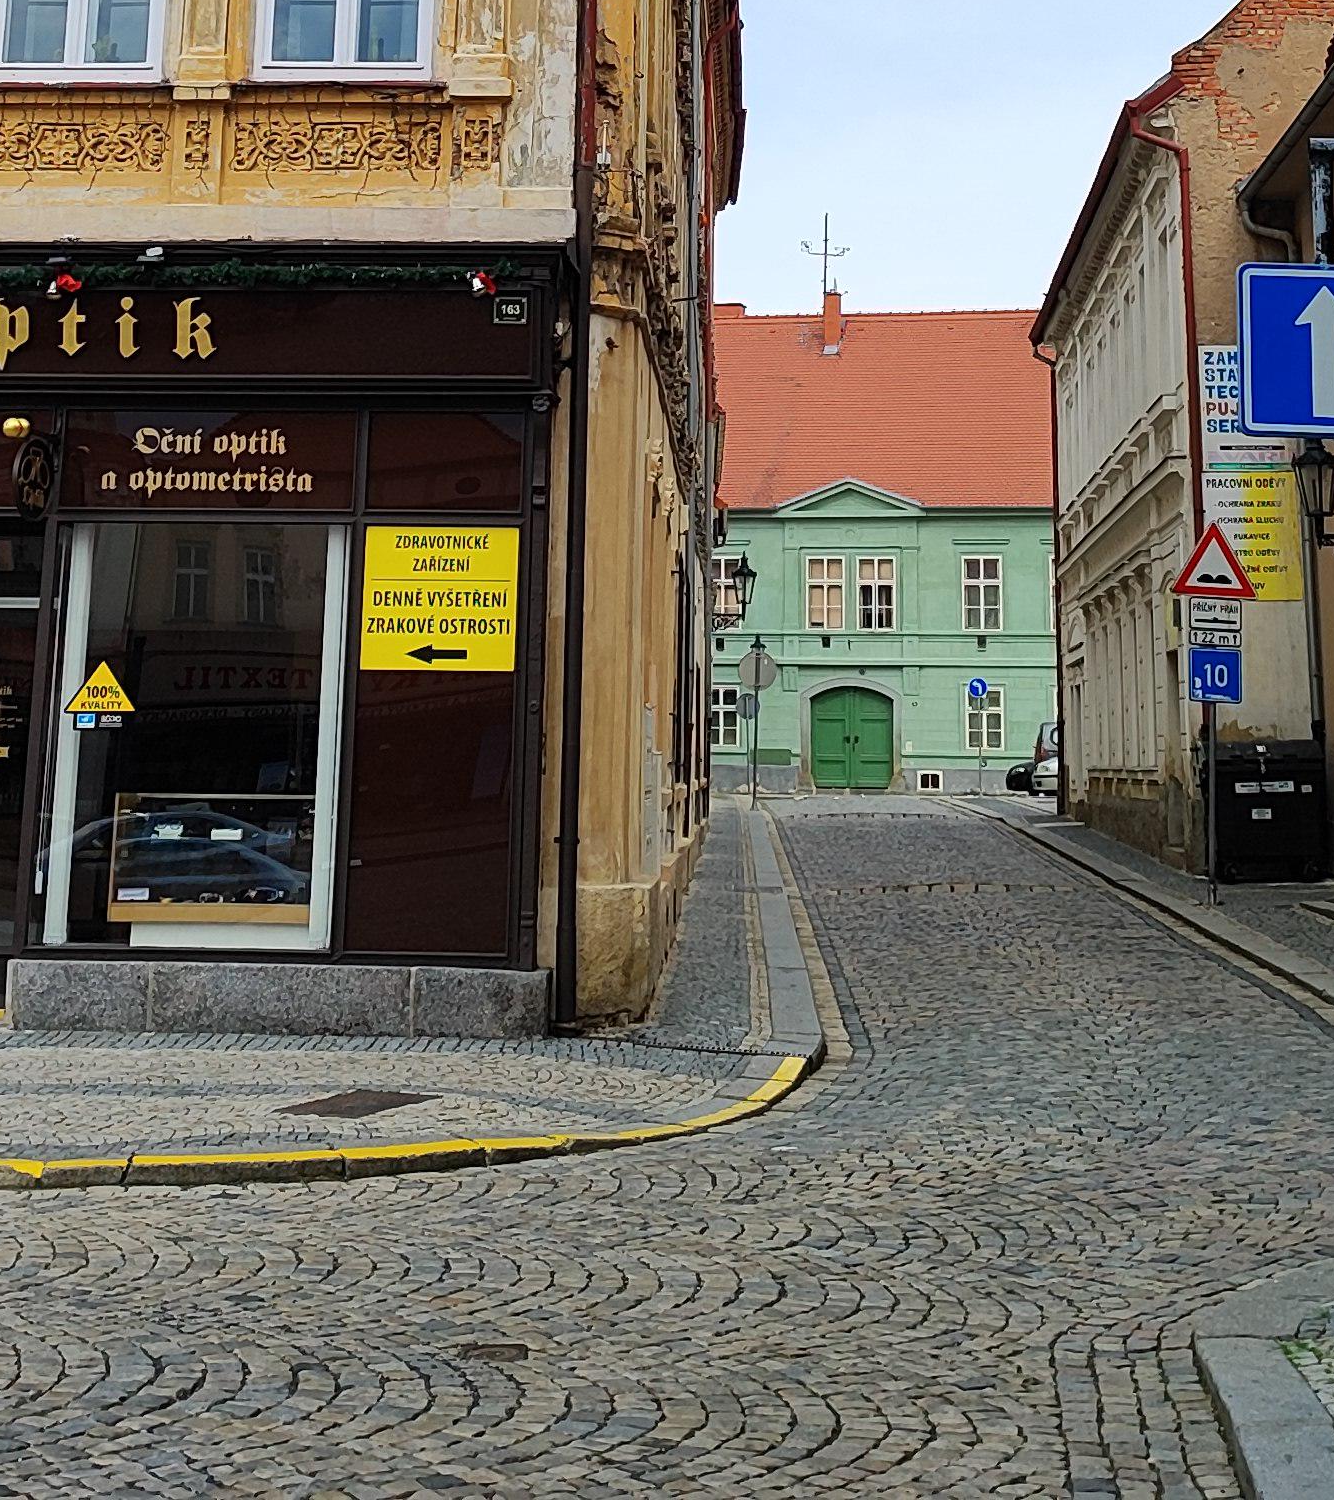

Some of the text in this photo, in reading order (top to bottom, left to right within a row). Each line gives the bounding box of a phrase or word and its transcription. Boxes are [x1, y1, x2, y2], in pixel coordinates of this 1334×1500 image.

[501, 304, 521, 315] 163
[1203, 351, 1239, 366] ZAH
[1204, 368, 1239, 382] STA
[1205, 385, 1240, 399] TEC
[1206, 418, 1243, 434] SER
[131, 427, 287, 463] Oční optik
[101, 465, 314, 499] a optometrista
[1206, 476, 1253, 489] PRACOVNÍ
[395, 533, 490, 550] ZDRAVOTNICKÉ
[412, 555, 471, 572] ZAŘÍZENÍ
[373, 588, 508, 608] DENNĚ VYŠETŘENÍ
[367, 615, 511, 635] ZRAKOVÉ OSTROSTI
[1201, 632, 1230, 644] 22 m
[1204, 663, 1228, 688] 10
[86, 685, 121, 699] 100%
[80, 701, 123, 709] KVALITY
